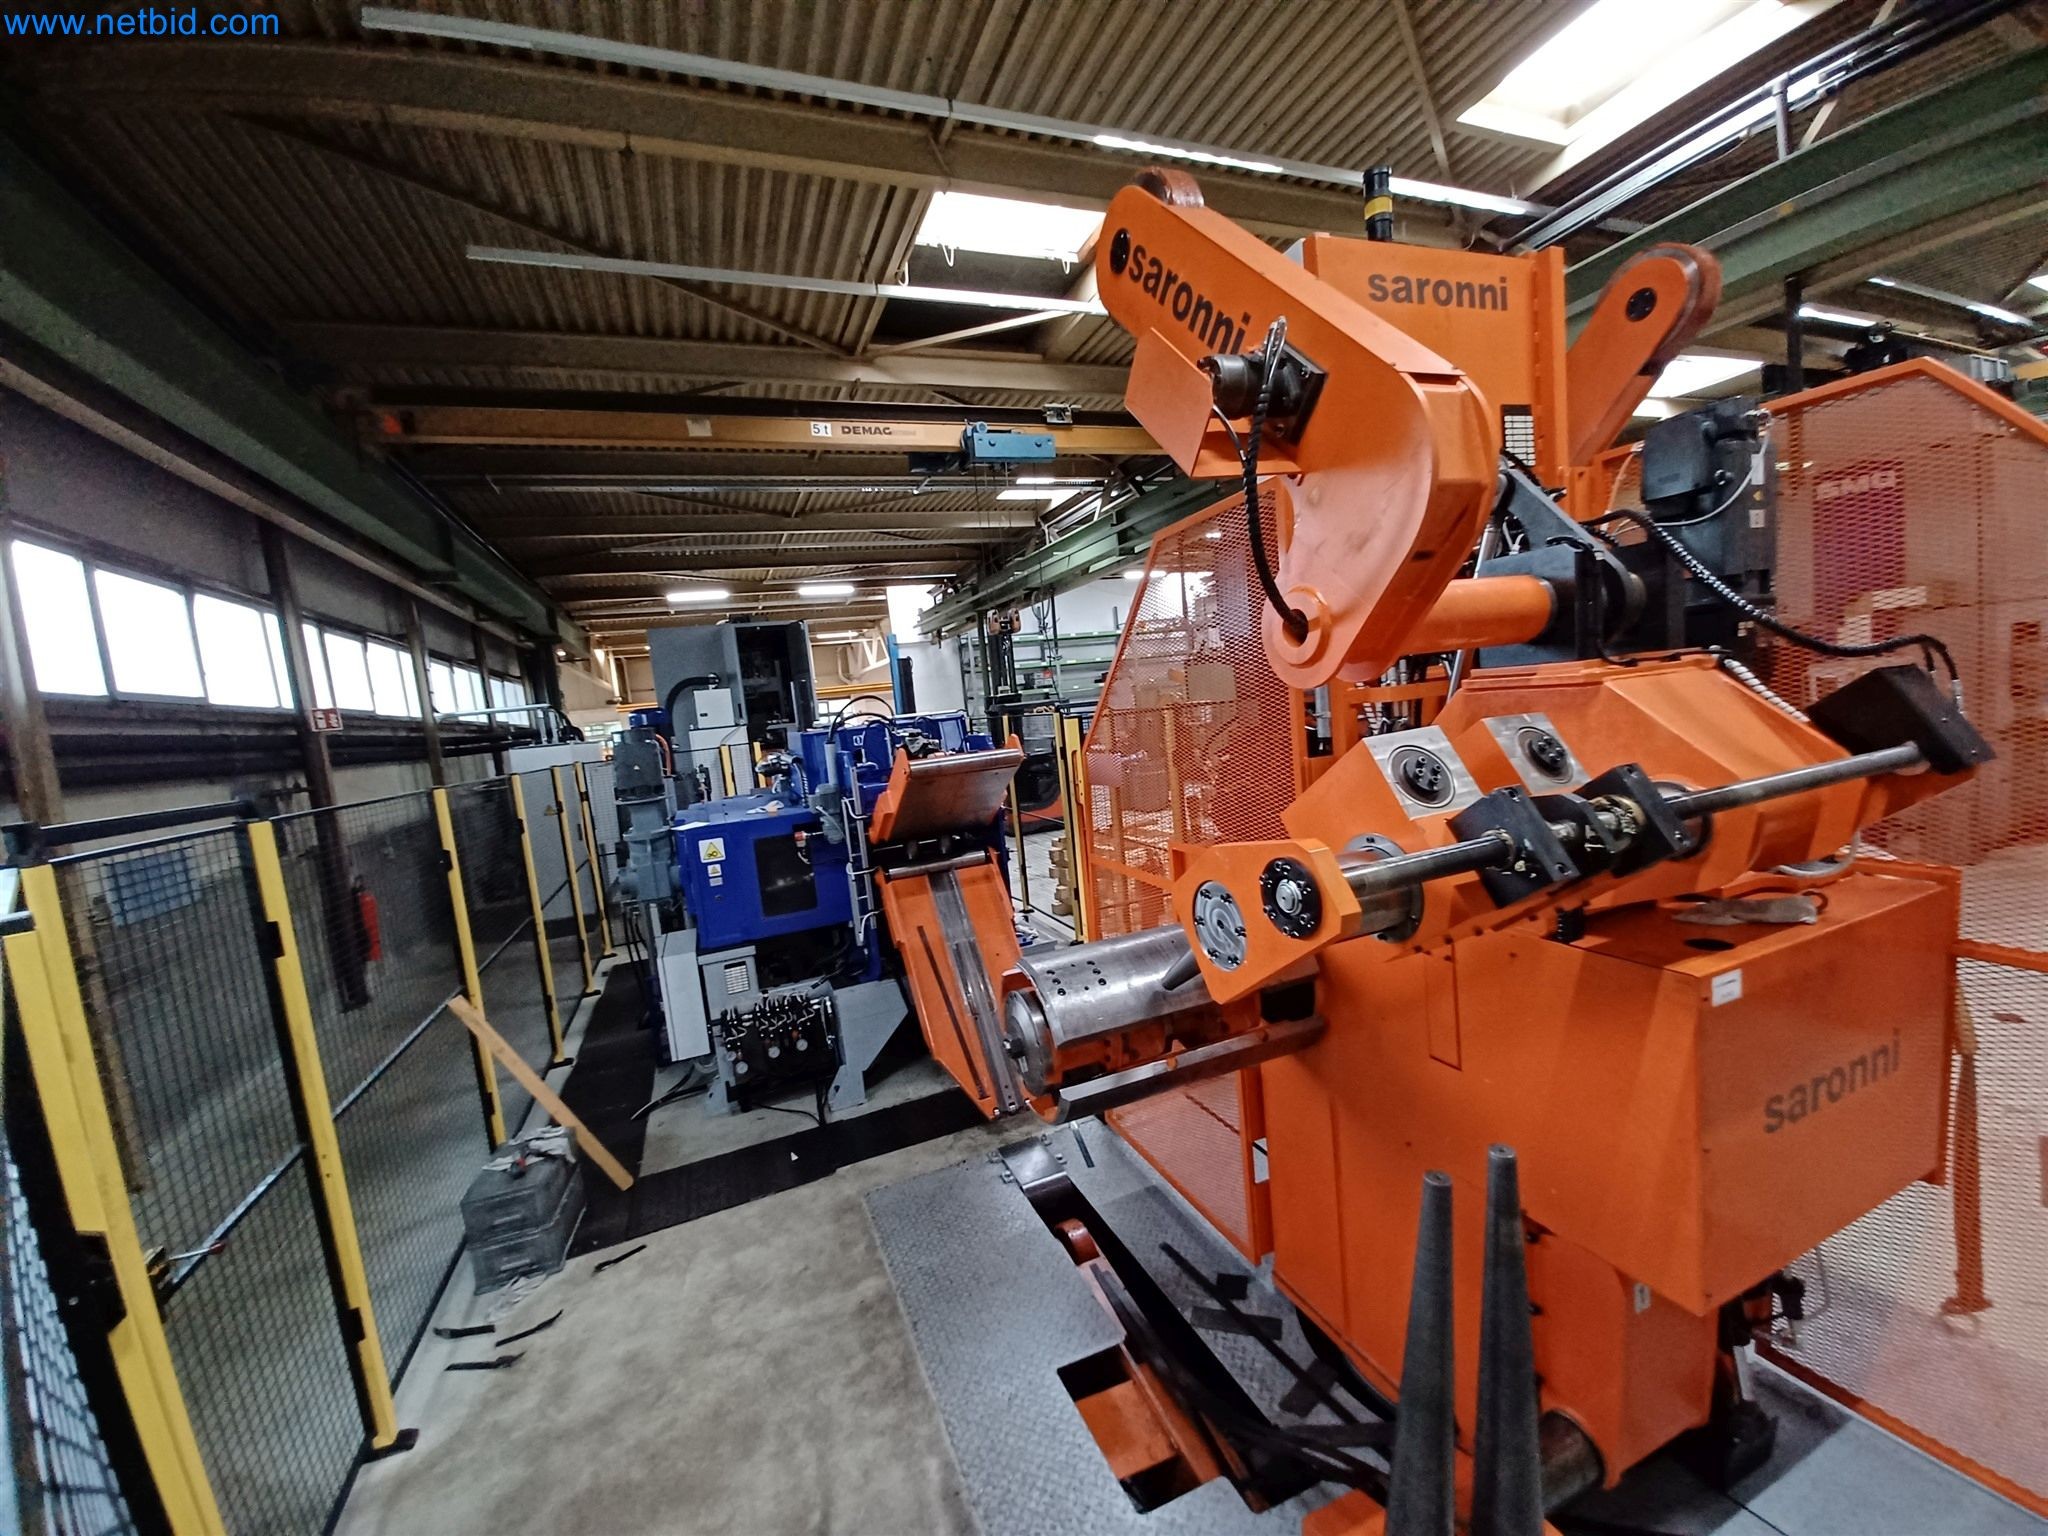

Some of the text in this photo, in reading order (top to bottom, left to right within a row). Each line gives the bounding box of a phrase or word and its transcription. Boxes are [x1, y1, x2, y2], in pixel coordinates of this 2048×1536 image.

[1128, 244, 1252, 355] saronni
[1367, 273, 1508, 311] saronni
[812, 423, 821, 435] 5
[841, 425, 892, 436] DEMAG
[1763, 1027, 1901, 1134] saronni
